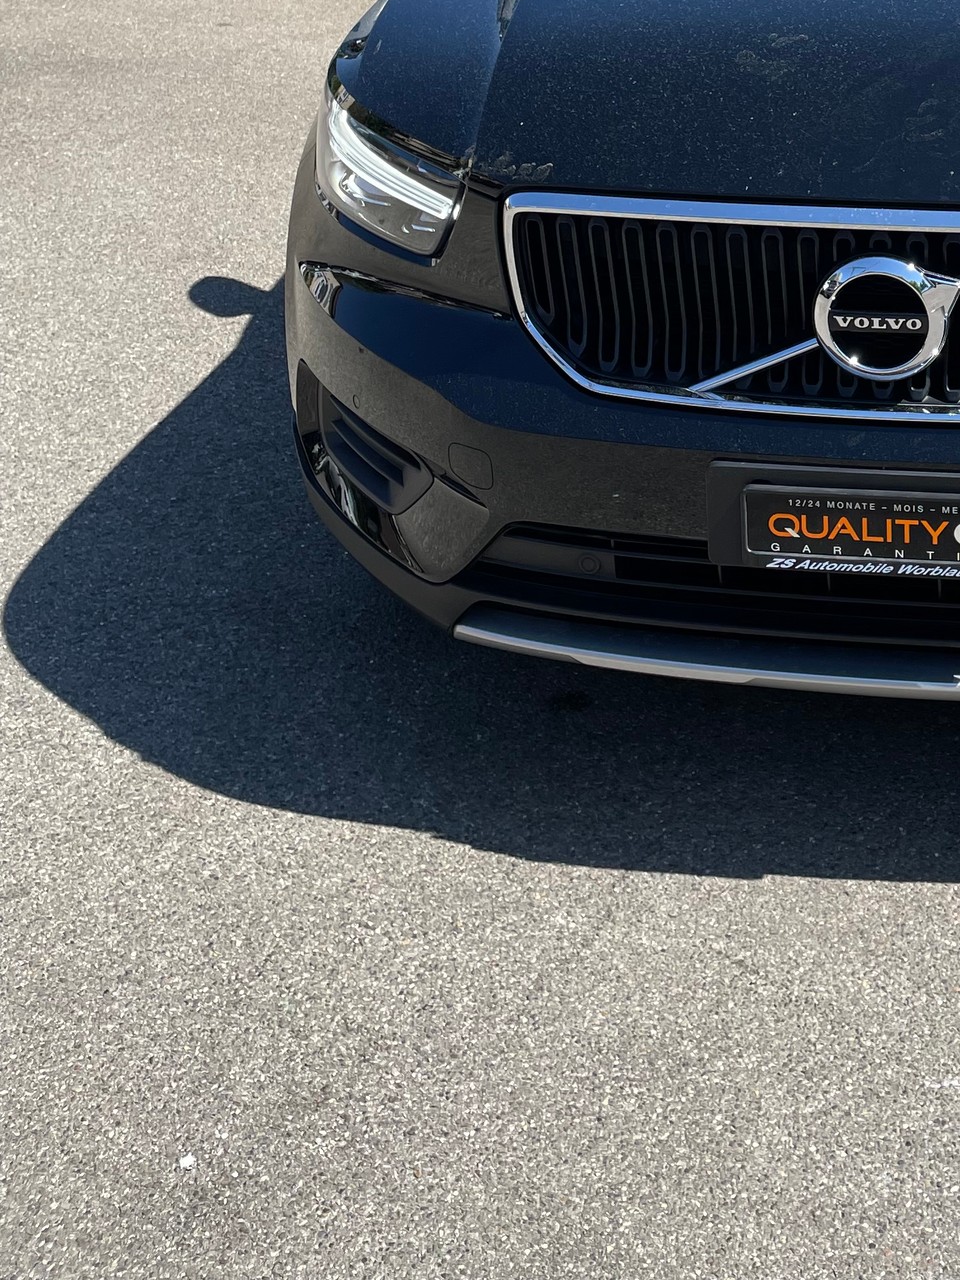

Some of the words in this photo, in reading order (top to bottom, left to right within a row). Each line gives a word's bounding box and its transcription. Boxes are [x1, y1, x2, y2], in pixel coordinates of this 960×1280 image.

[833, 316, 922, 330] VOLVO
[788, 499, 820, 508] 12/24
[826, 501, 876, 511] MONATE
[893, 504, 924, 513] MOIS
[768, 513, 950, 545] QUALITY
[766, 558, 797, 569] ZS
[795, 559, 894, 574] Automobile
